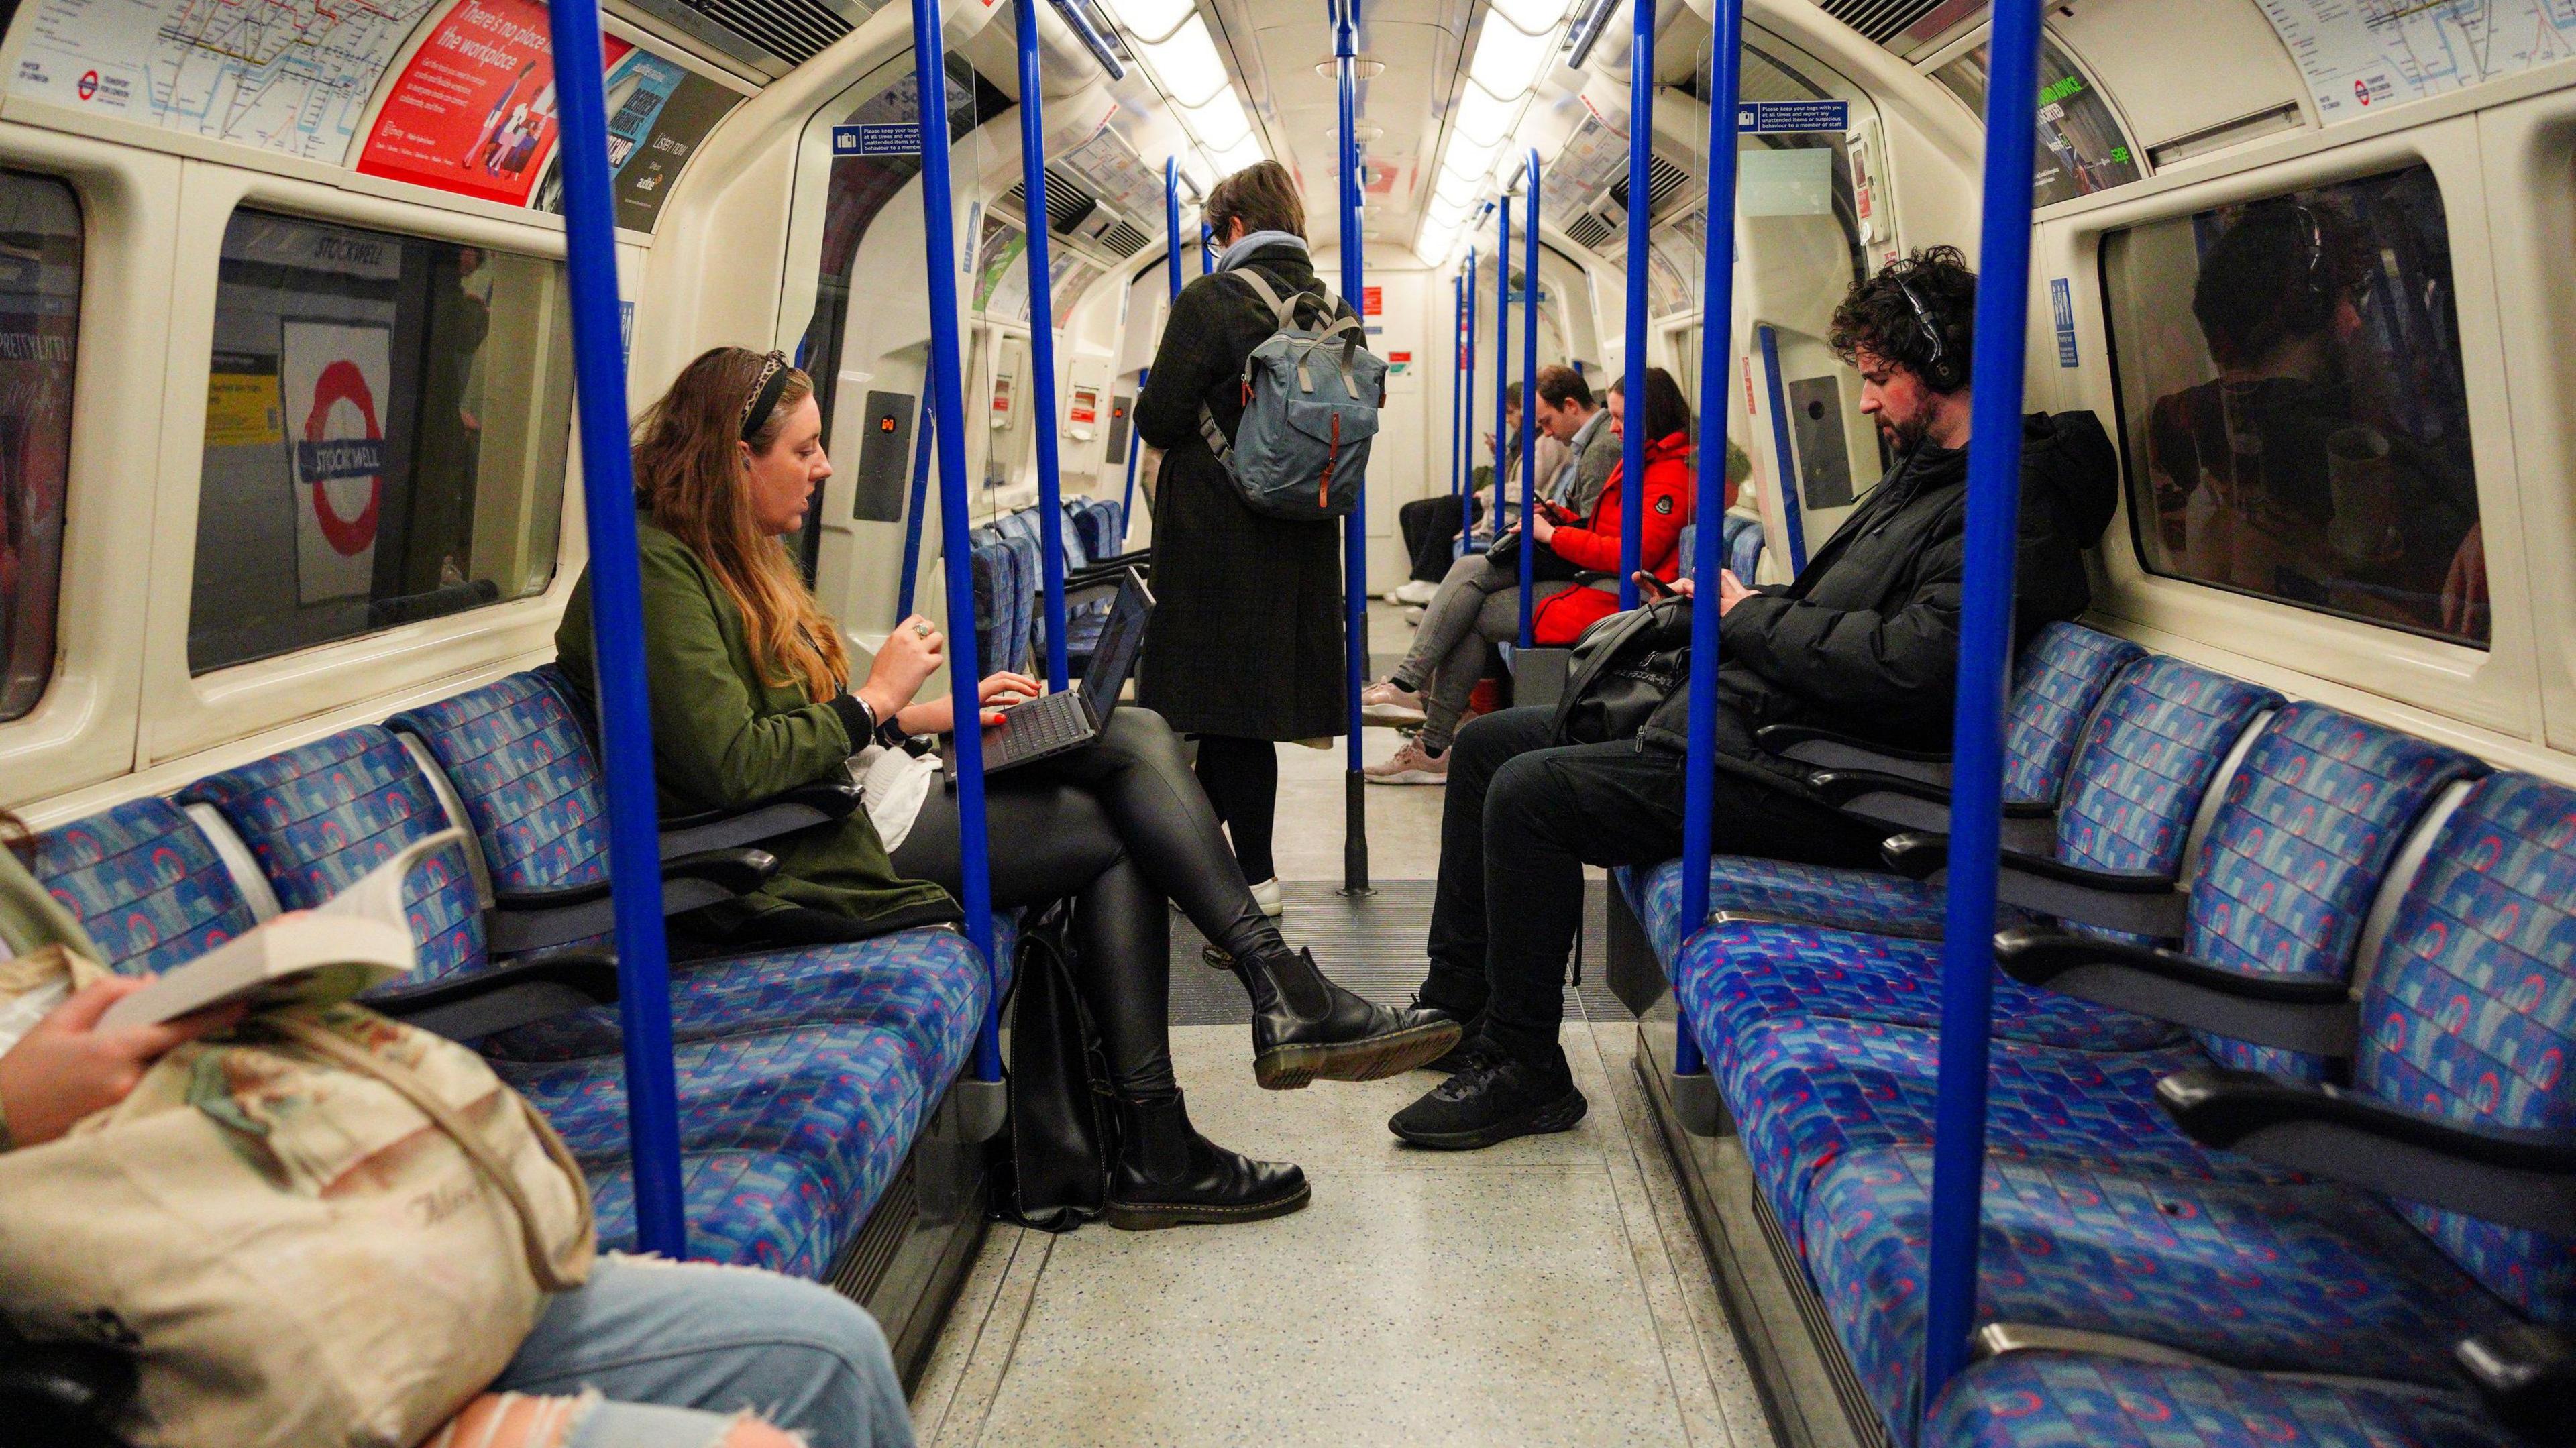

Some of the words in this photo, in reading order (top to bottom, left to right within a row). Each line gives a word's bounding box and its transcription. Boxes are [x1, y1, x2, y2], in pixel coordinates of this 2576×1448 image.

[460, 1, 504, 32] There's
[498, 21, 518, 38] no
[508, 25, 547, 50] place
[437, 25, 463, 50] the
[459, 39, 518, 70] workplace
[653, 132, 675, 153] Listen
[672, 142, 689, 156] now
[314, 236, 384, 266] STOCKWELL
[316, 447, 381, 474] STOCKWELL
